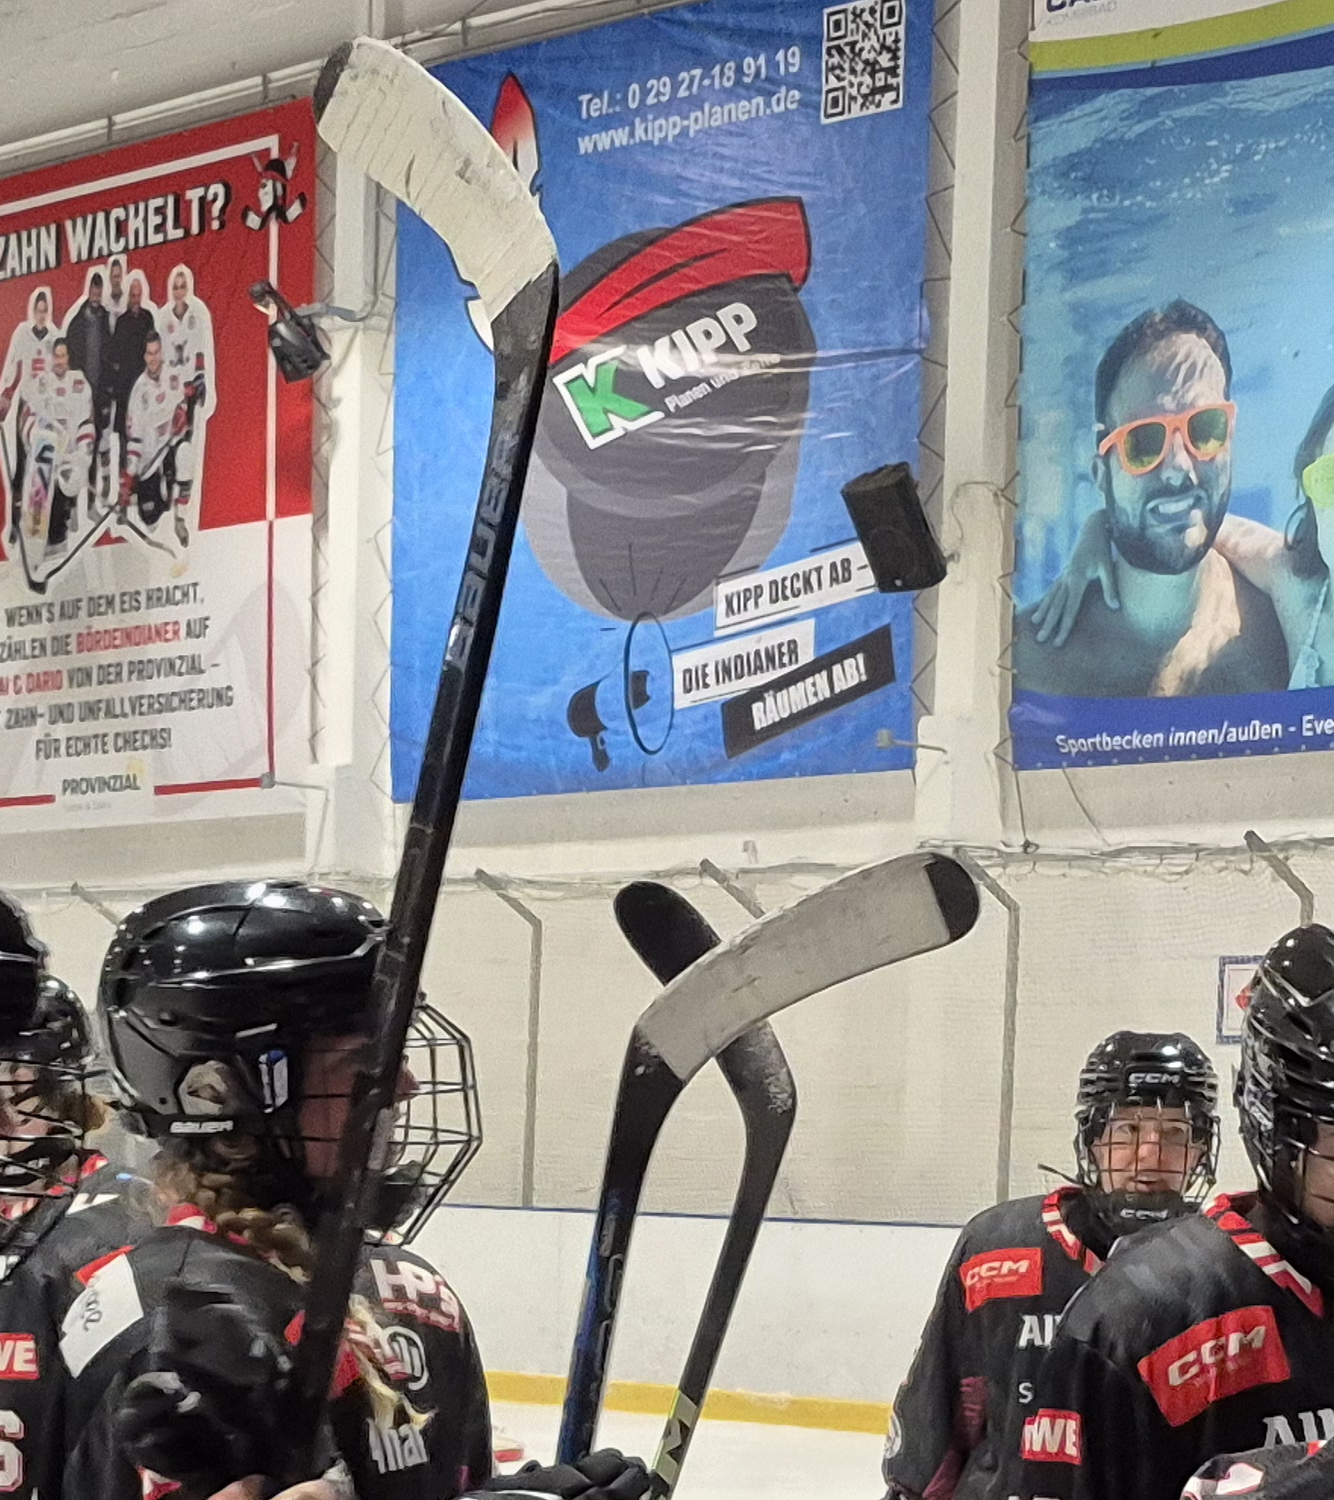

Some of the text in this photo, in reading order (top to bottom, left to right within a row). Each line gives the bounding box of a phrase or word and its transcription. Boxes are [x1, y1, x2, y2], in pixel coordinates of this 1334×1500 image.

[578, 46, 801, 120] Tel.: 0 29 27-18 91 19
[577, 85, 801, 155] www.kipp-planen.de
[66, 181, 233, 265] WACKELT?
[636, 302, 757, 389] KIPP
[664, 382, 712, 413] Planen
[59, 598, 83, 621] AUF
[87, 593, 116, 618] DEM
[119, 590, 142, 613] EIS
[724, 583, 764, 618] KIPP
[768, 565, 824, 604] DECKT
[829, 557, 853, 588] AB
[0, 616, 210, 663] ZÄHLEN DIE BÖRDEINDIANER AUF
[68, 665, 93, 689] VON
[96, 662, 123, 686] DER
[127, 654, 206, 682] PROVINZIAL
[682, 638, 799, 695] DIE INDIANER
[4, 706, 45, 730] ZAHN-
[48, 702, 75, 726] UND
[78, 685, 235, 722] UNFALLVERSICHERUNG
[751, 652, 868, 731] RÄUMEN AB!
[35, 732, 62, 760] FÜR
[66, 733, 110, 758] ECHTE
[1056, 729, 1164, 756] Sportbecken
[1169, 720, 1283, 746] innen/außen
[62, 773, 142, 796] PROVINZIAL
[1128, 1072, 1181, 1084] CCM
[965, 1259, 1030, 1287] CCM
[1168, 1326, 1266, 1386] CCM
